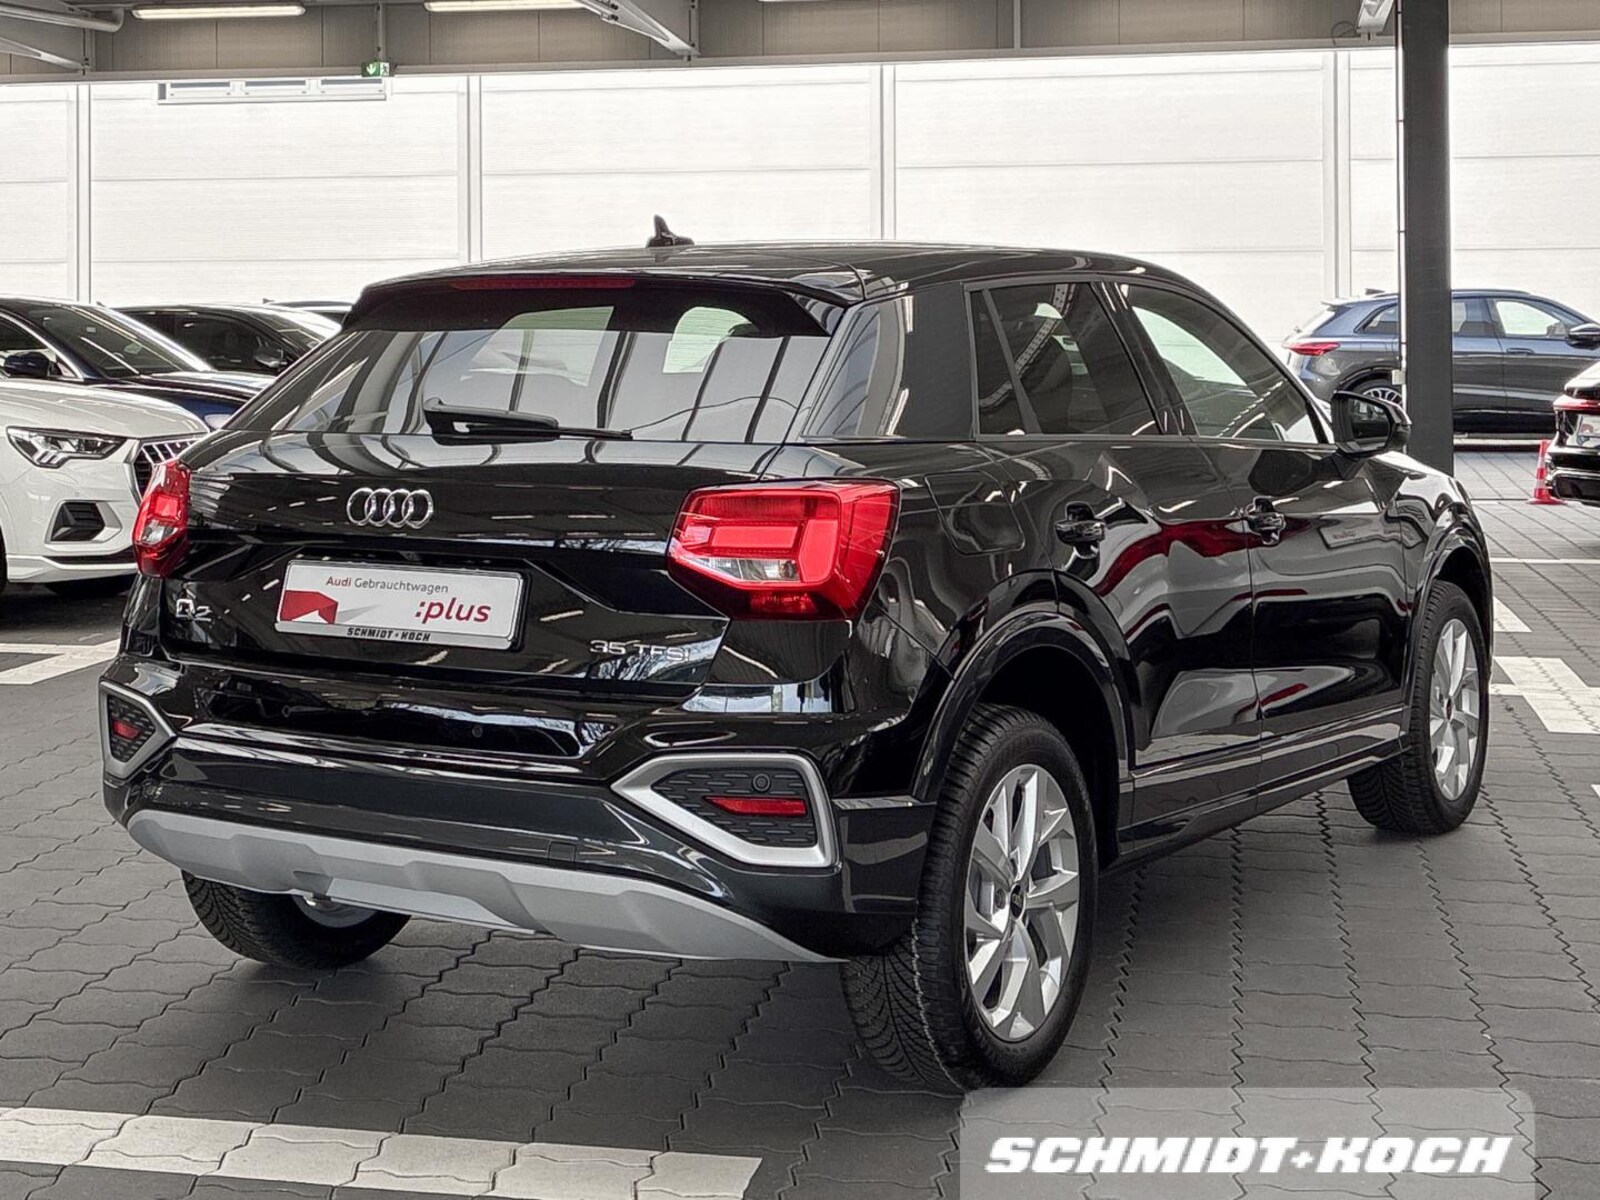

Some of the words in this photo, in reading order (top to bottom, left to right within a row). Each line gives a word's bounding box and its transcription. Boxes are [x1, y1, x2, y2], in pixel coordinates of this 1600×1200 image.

[325, 576, 352, 587] Audi
[354, 577, 449, 595] Gebrauchtwagen
[589, 639, 627, 655] 35
[632, 643, 690, 662] TFSI
